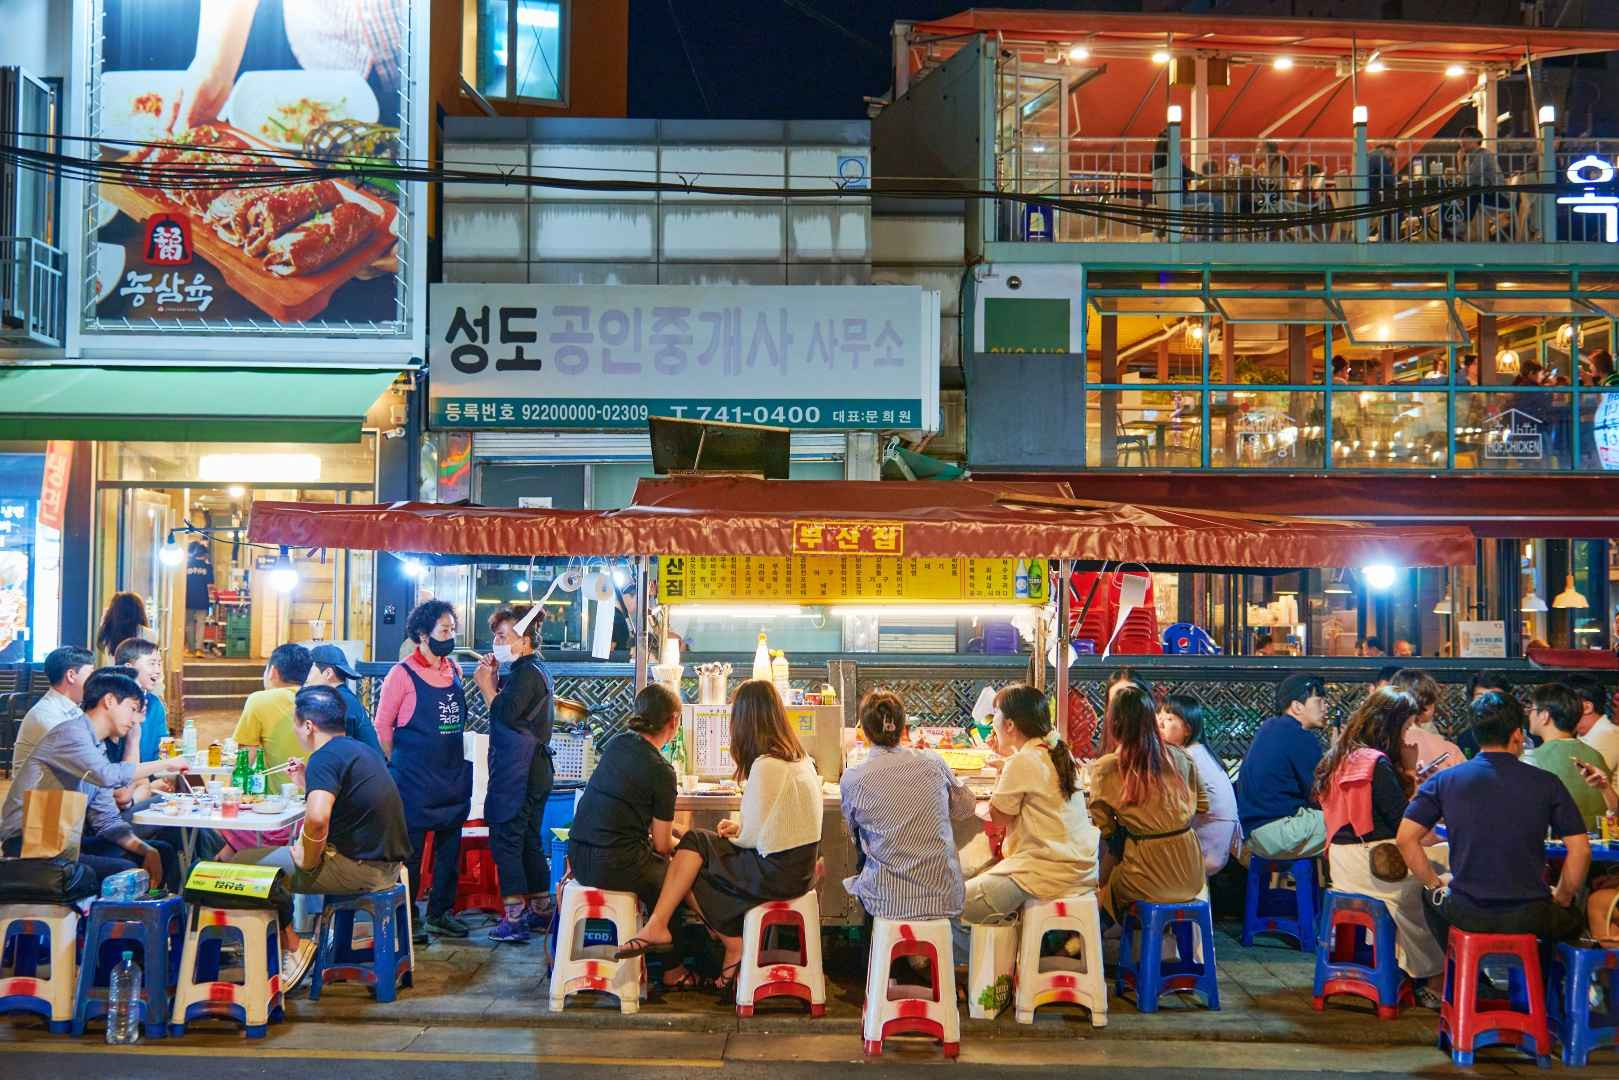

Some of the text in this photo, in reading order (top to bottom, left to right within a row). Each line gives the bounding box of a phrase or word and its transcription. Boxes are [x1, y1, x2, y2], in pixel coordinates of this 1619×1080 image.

[805, 317, 905, 370] 사무소
[445, 402, 515, 422] 등록번호
[521, 403, 649, 421] 92200000-02309
[696, 405, 821, 423] 741-0400
